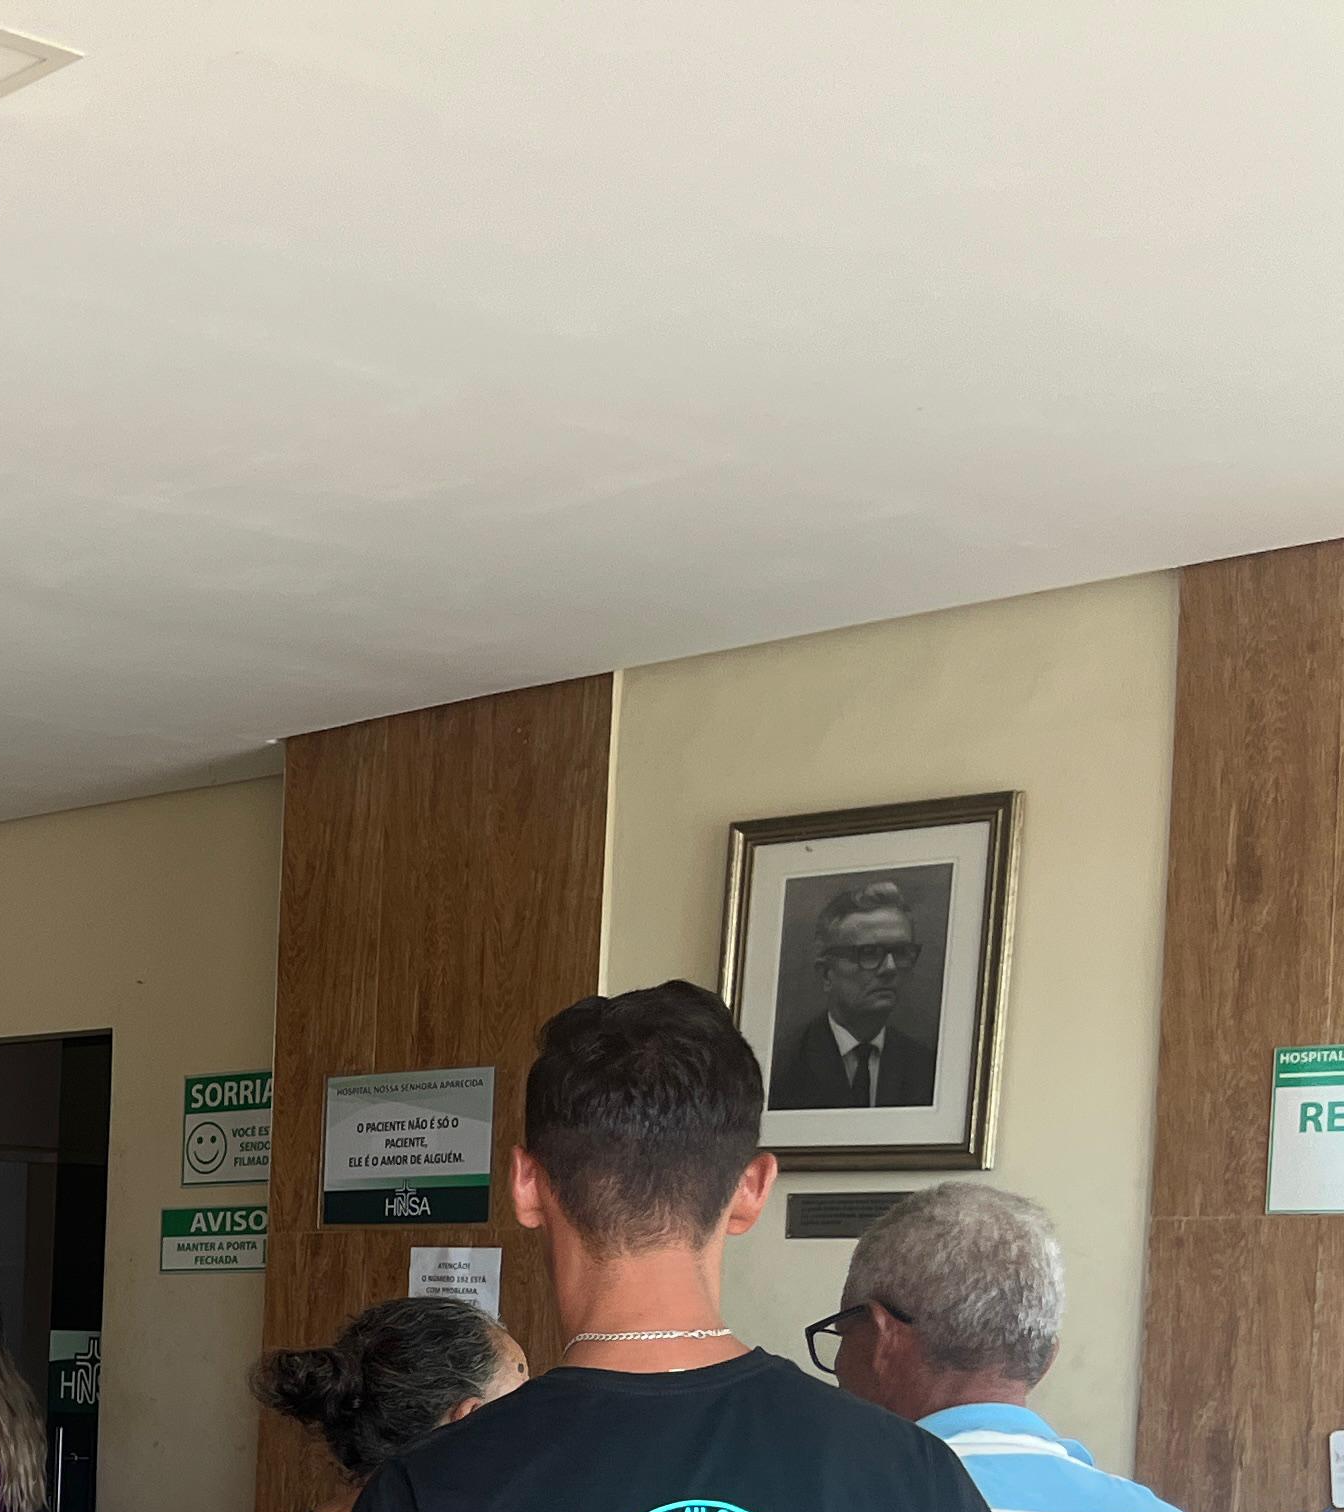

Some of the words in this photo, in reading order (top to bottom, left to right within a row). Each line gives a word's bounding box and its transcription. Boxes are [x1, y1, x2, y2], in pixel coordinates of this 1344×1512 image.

[1279, 1050, 1344, 1064] HOSPITAL
[191, 1078, 272, 1108] SORRIA
[337, 1086, 372, 1096] HOSPITAL
[374, 1084, 398, 1093] NOSSA
[401, 1082, 438, 1092] SENHORA
[440, 1079, 484, 1089] APARECIDA
[357, 1123, 363, 1133] O
[366, 1121, 406, 1133] PACIENTE
[408, 1118, 427, 1130] NÃO
[430, 1116, 435, 1129] É
[437, 1115, 449, 1128] SÓ
[451, 1117, 459, 1128] O
[232, 1126, 256, 1137] VOCÊ
[258, 1126, 269, 1136] ES
[385, 1137, 428, 1149] PACIENTE,
[233, 1155, 269, 1167] FILMAD
[348, 1156, 362, 1167] ELE
[365, 1154, 370, 1167] É
[372, 1156, 378, 1166] O
[380, 1154, 407, 1165] AMOR
[410, 1154, 421, 1165] DE
[424, 1152, 464, 1164] ALGUÉM.
[385, 1196, 431, 1216] HNSA
[190, 1210, 267, 1233] AVISO
[177, 1242, 215, 1252] MANTER
[217, 1242, 225, 1251] A
[226, 1240, 257, 1251] PORTA
[194, 1255, 238, 1265] FECHADA
[421, 1275, 427, 1283] O
[425, 1286, 440, 1294] COM
[61, 1368, 100, 1404] HN
